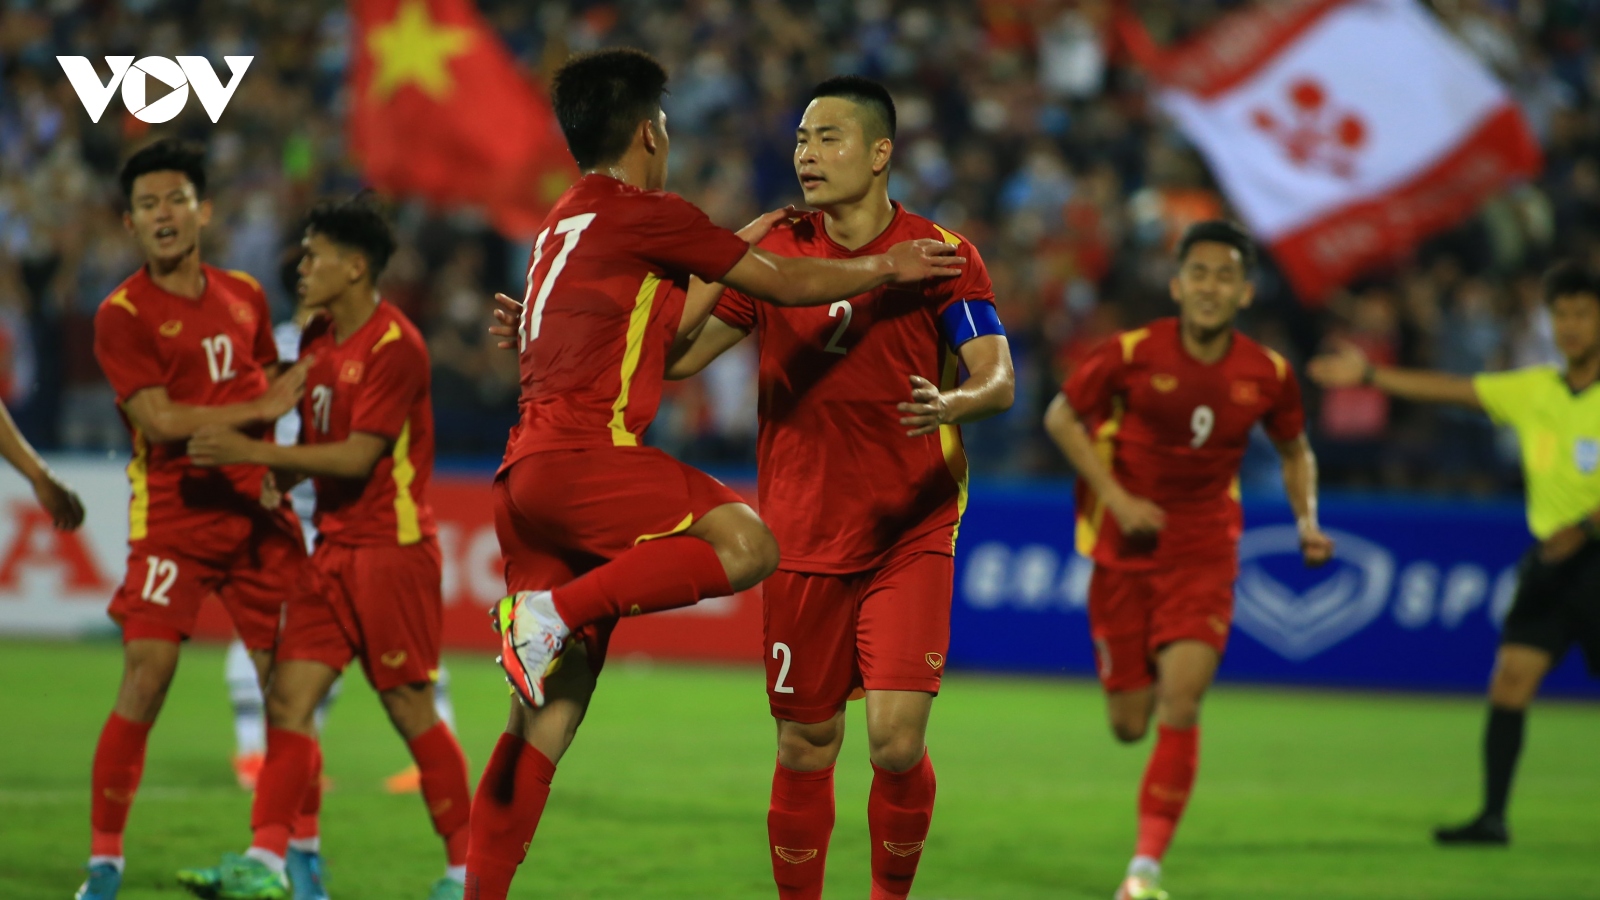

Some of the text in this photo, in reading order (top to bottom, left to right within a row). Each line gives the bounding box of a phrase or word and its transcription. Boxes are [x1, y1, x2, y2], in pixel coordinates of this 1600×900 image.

[518, 212, 597, 354] 17
[823, 299, 853, 355] 2
[201, 334, 237, 383] 12
[1190, 405, 1215, 449] 9
[141, 555, 179, 606] 12
[772, 641, 795, 694] 2
